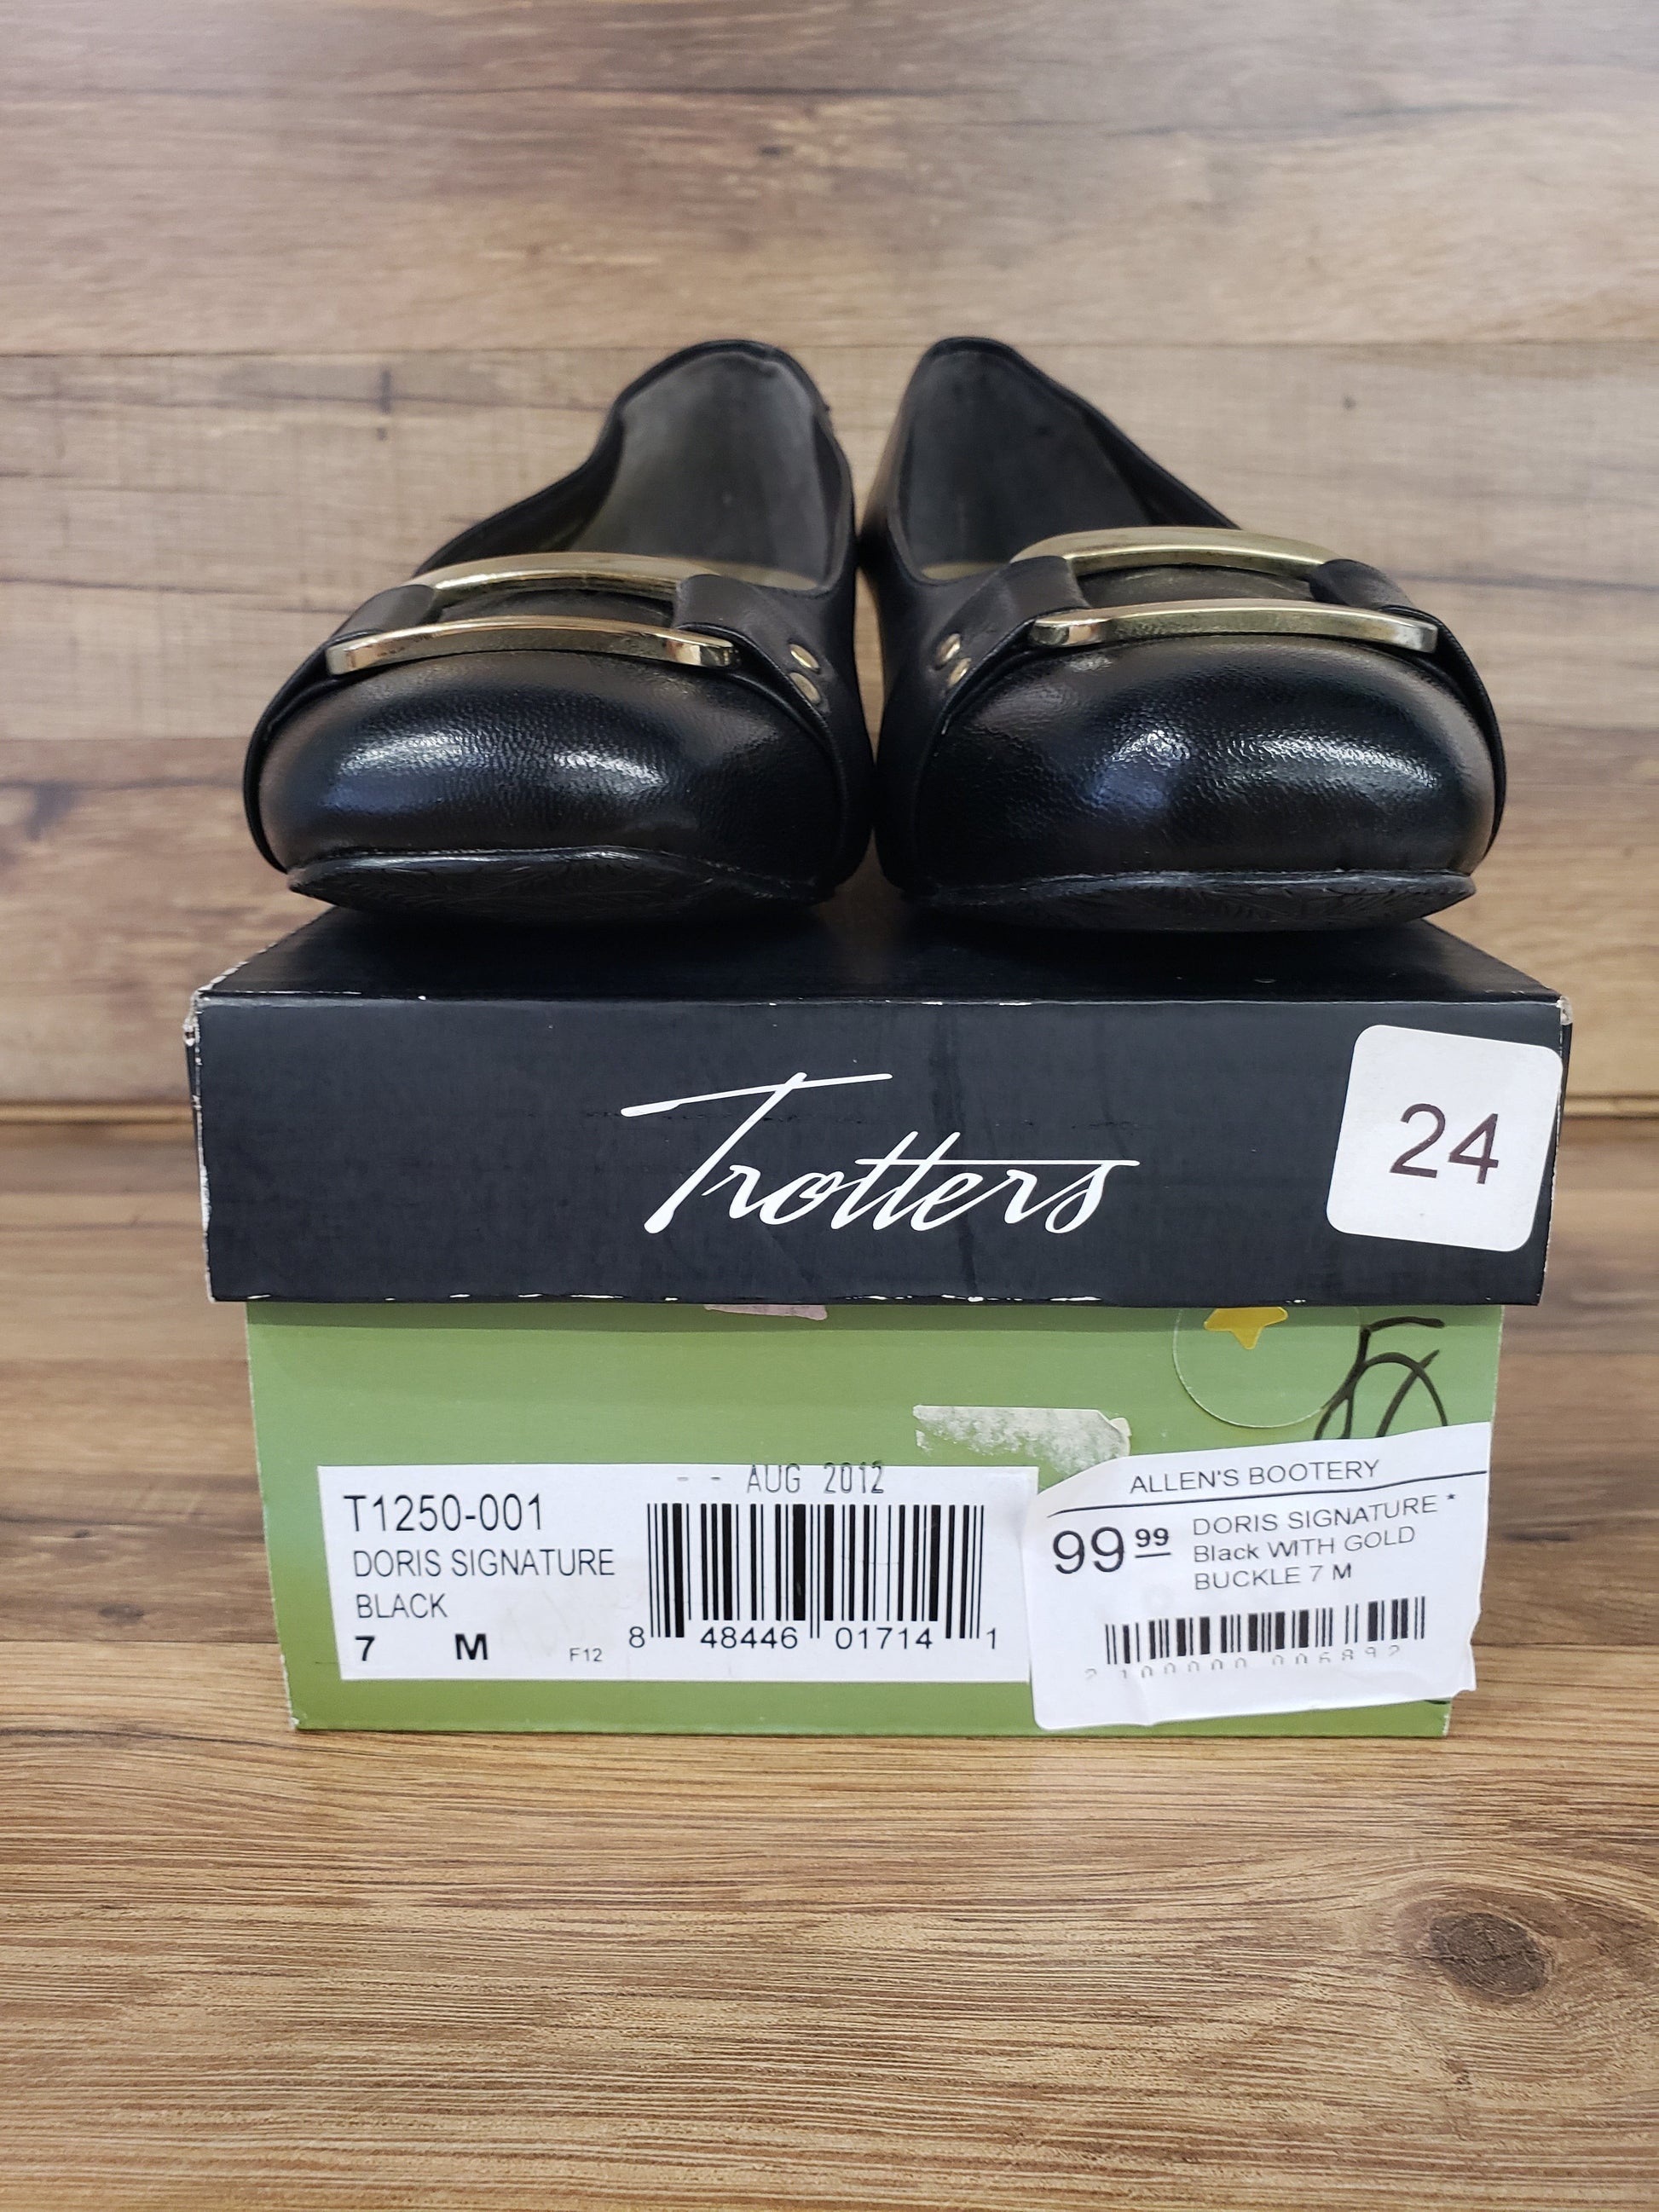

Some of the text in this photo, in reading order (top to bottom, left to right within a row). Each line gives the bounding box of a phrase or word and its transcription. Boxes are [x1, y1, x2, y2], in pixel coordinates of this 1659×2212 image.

[621, 1071, 1140, 1234] Trotters
[1390, 1101, 1500, 1186] 24
[747, 1459, 885, 1494] AUG 2012
[1130, 1458, 1380, 1495] ALLEN'S BOOTERY
[343, 1493, 541, 1532] T1250-001
[1193, 1495, 1438, 1536] DORIS SIGNATURE
[1052, 1526, 1170, 1575] 99 99
[1194, 1526, 1415, 1562] Black WITH GOLD
[354, 1547, 616, 1577] DORIS SIGNATURE
[1194, 1562, 1352, 1591] BUCKLE 7 M
[356, 1592, 448, 1619] BLACK
[355, 1633, 488, 1662] 7 M
[569, 1648, 603, 1662] F12
[629, 1626, 997, 1650] 8 48446 01714 1
